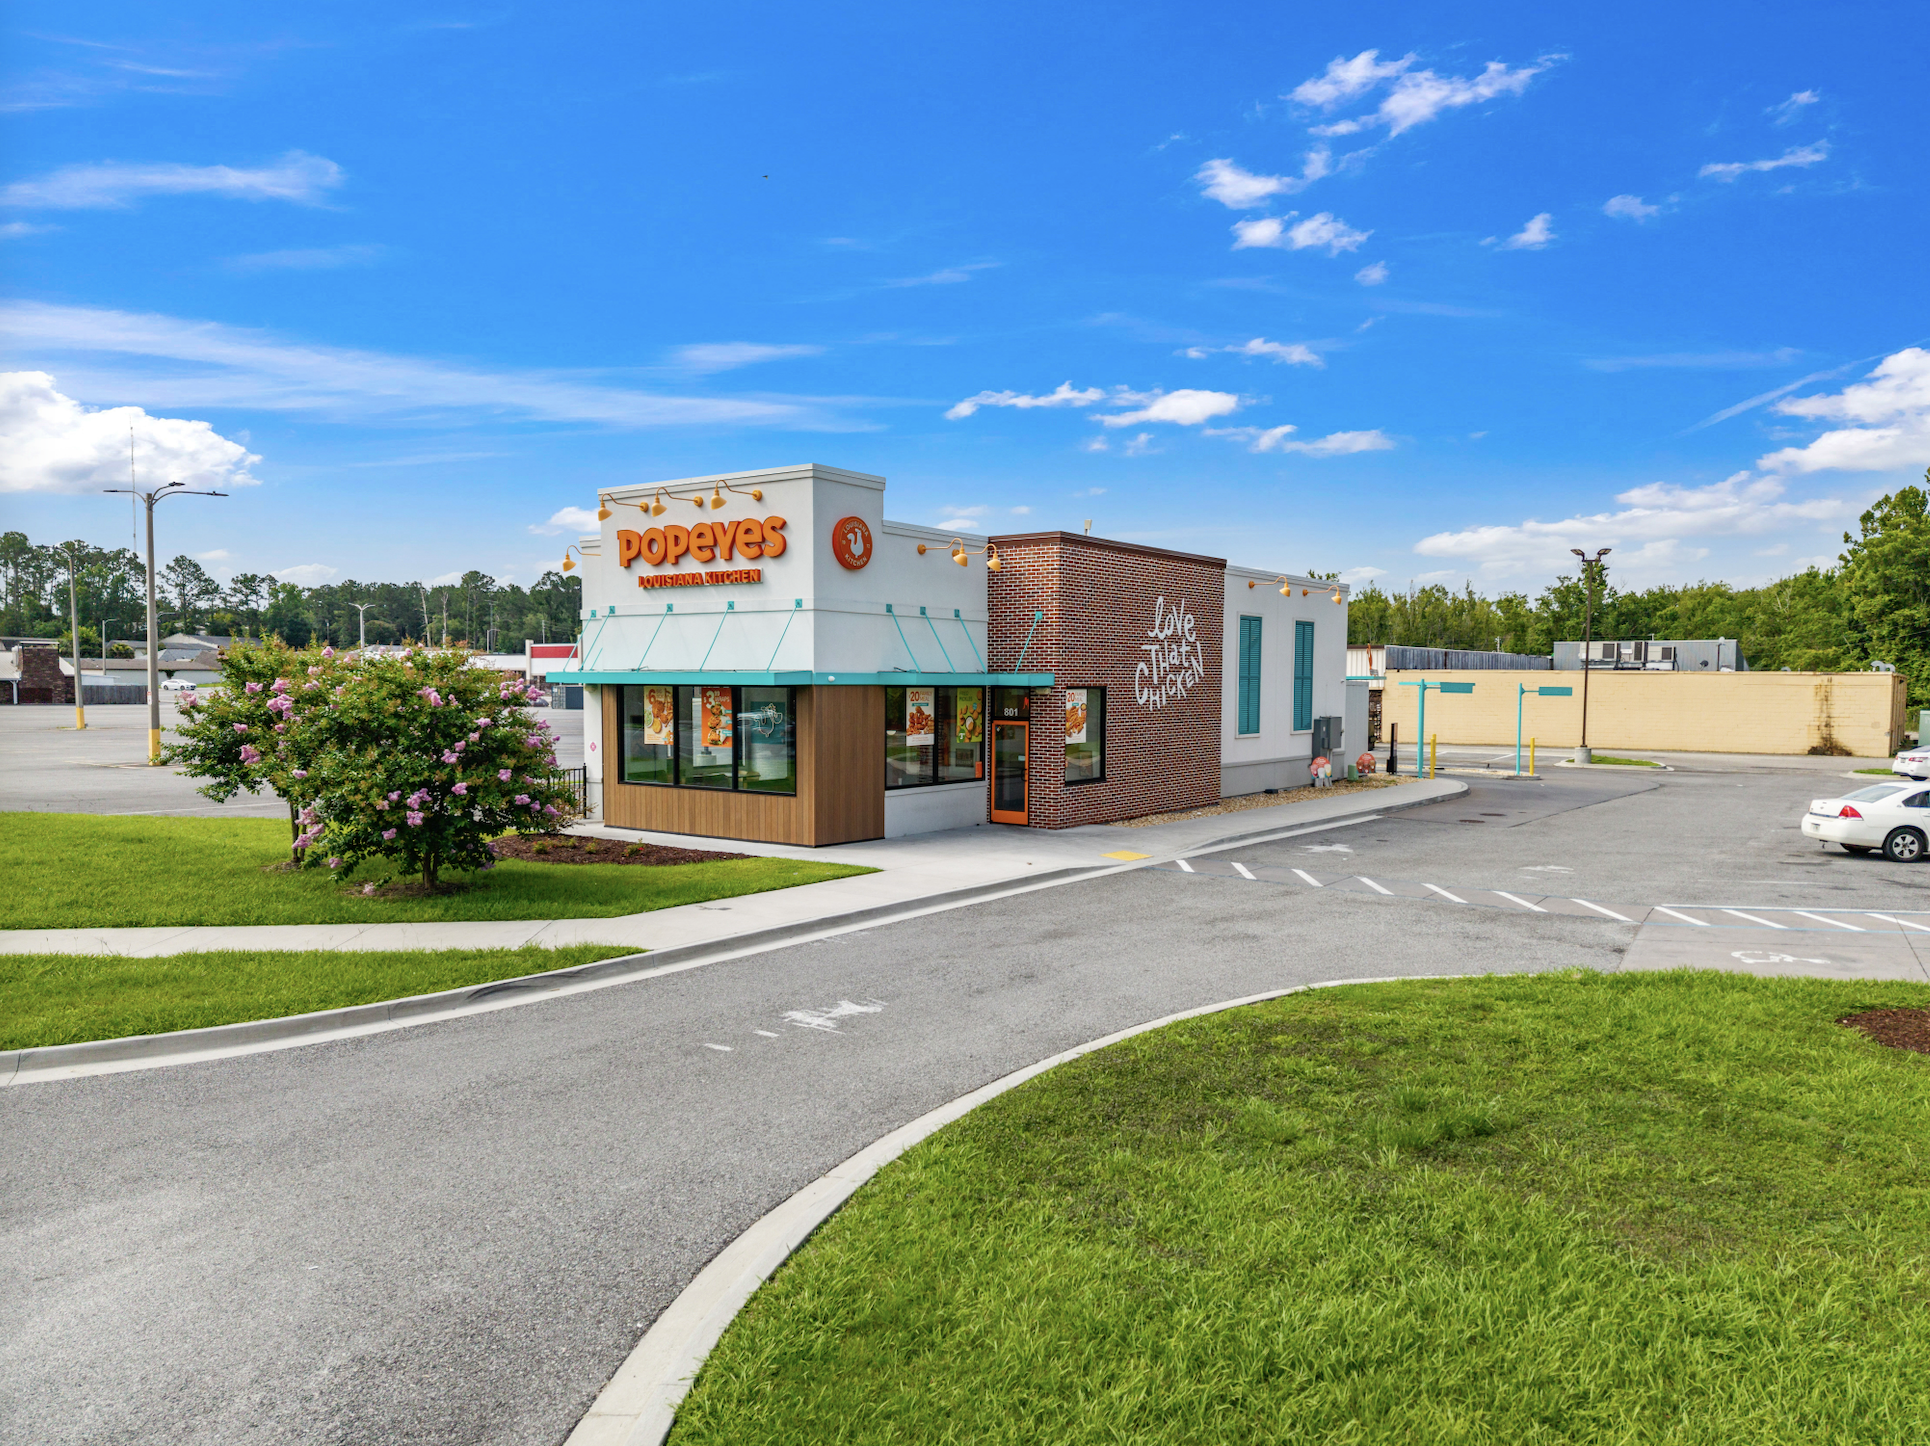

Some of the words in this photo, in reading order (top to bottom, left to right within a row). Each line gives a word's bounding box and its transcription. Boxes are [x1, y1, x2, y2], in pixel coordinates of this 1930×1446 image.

[638, 572, 704, 588] LOUISIANA
[705, 568, 762, 584] KITCHEN
[1003, 707, 1019, 717] 801
